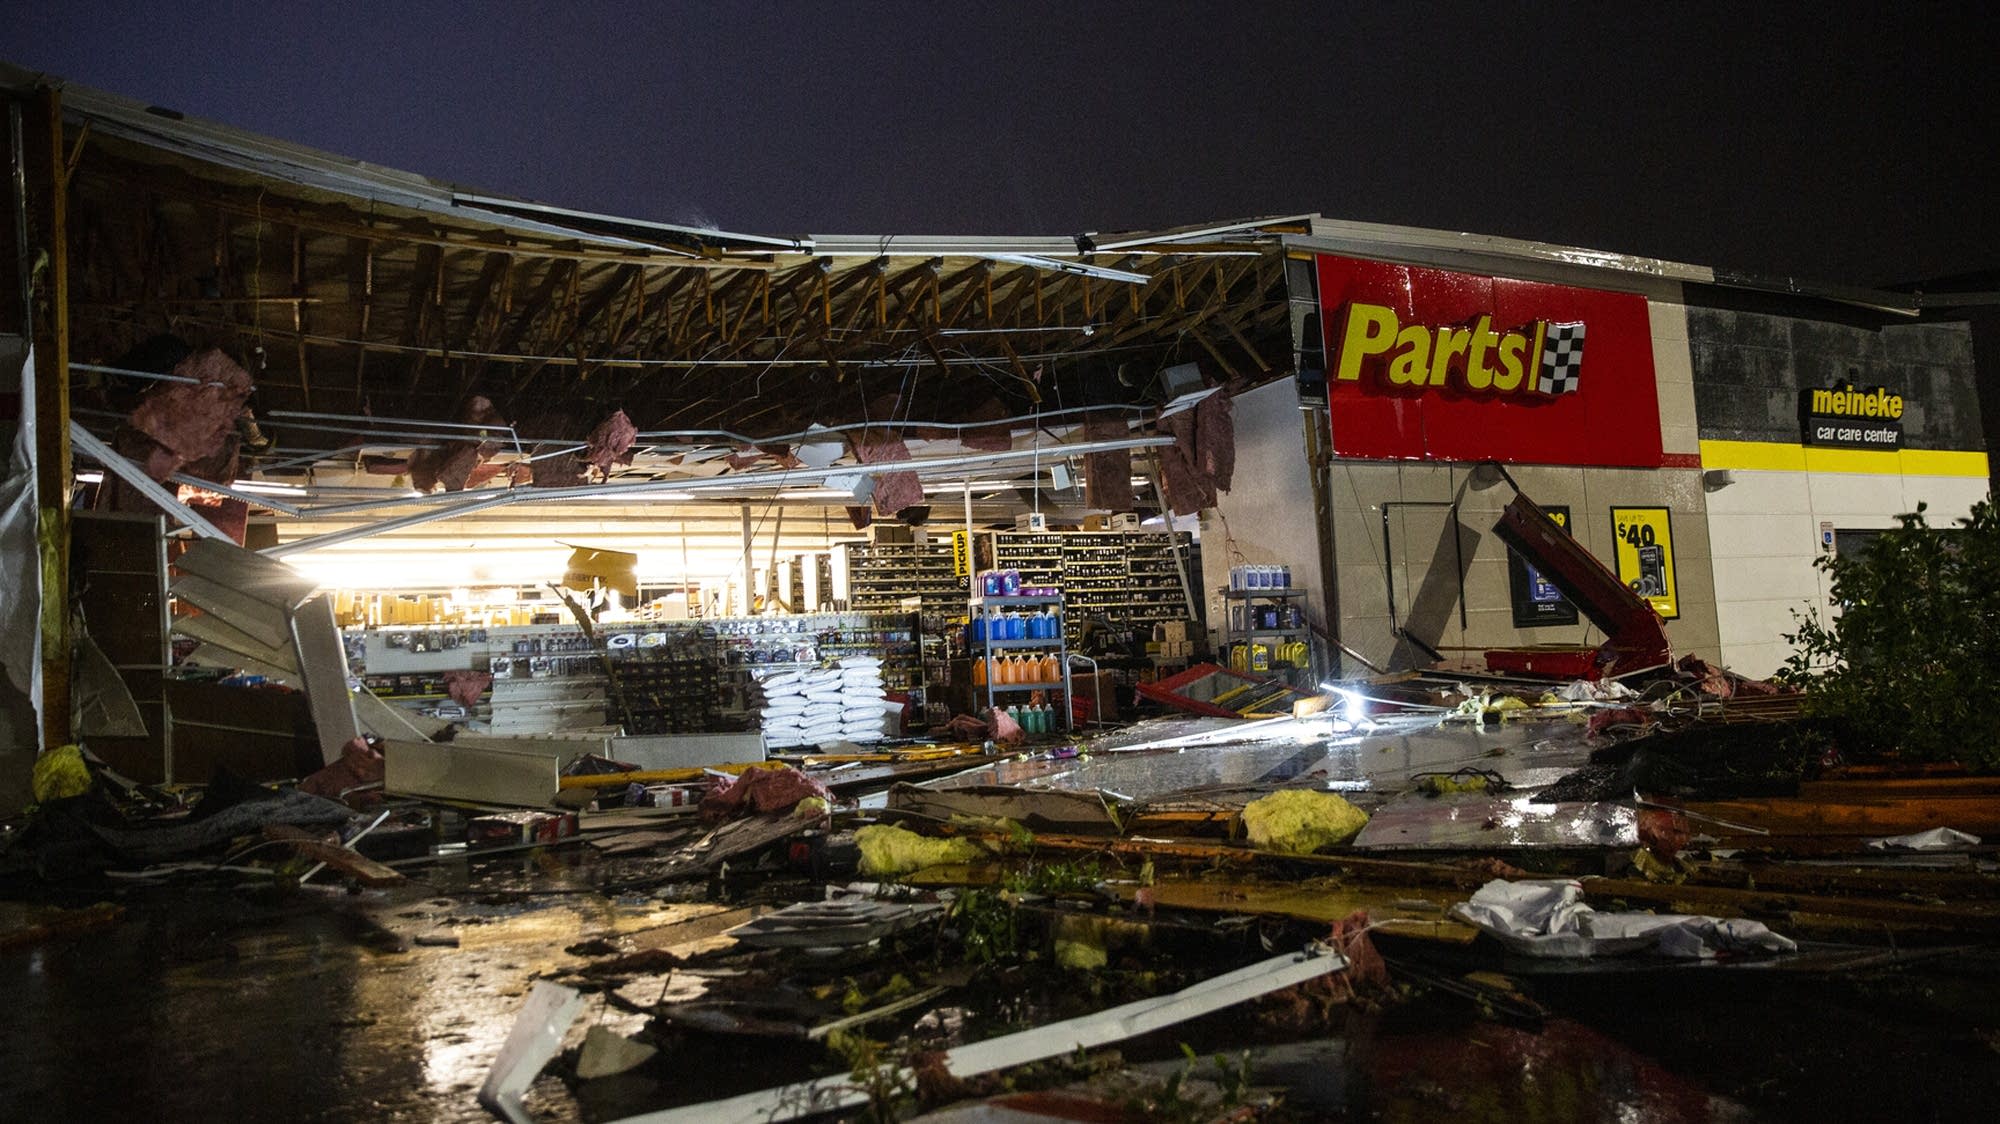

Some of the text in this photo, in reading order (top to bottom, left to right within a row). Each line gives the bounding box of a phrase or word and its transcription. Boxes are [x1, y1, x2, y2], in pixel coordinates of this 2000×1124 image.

[1337, 302, 1527, 391] Parts
[1812, 384, 1903, 418] meineke
[1817, 427, 1898, 443] car care center
[1618, 521, 1655, 548] $40
[957, 534, 967, 574] PICKUP
